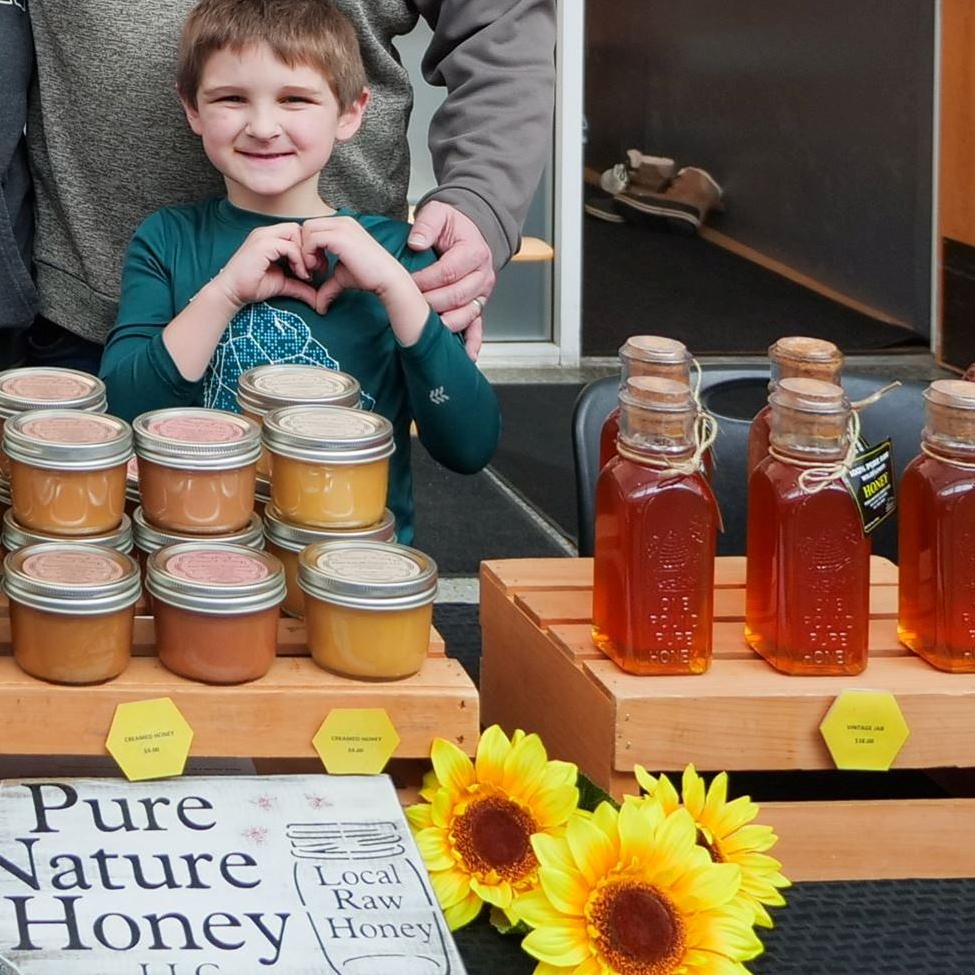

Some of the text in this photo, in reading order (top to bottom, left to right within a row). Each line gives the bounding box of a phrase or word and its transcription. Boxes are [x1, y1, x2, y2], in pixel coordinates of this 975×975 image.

[863, 471, 889, 499] HONEY
[124, 734, 152, 743] CREAMED
[24, 782, 217, 833] Pure
[317, 863, 403, 887] Local
[336, 888, 403, 911] Raw
[5, 895, 292, 966] Honey
[328, 917, 434, 944] Honey
